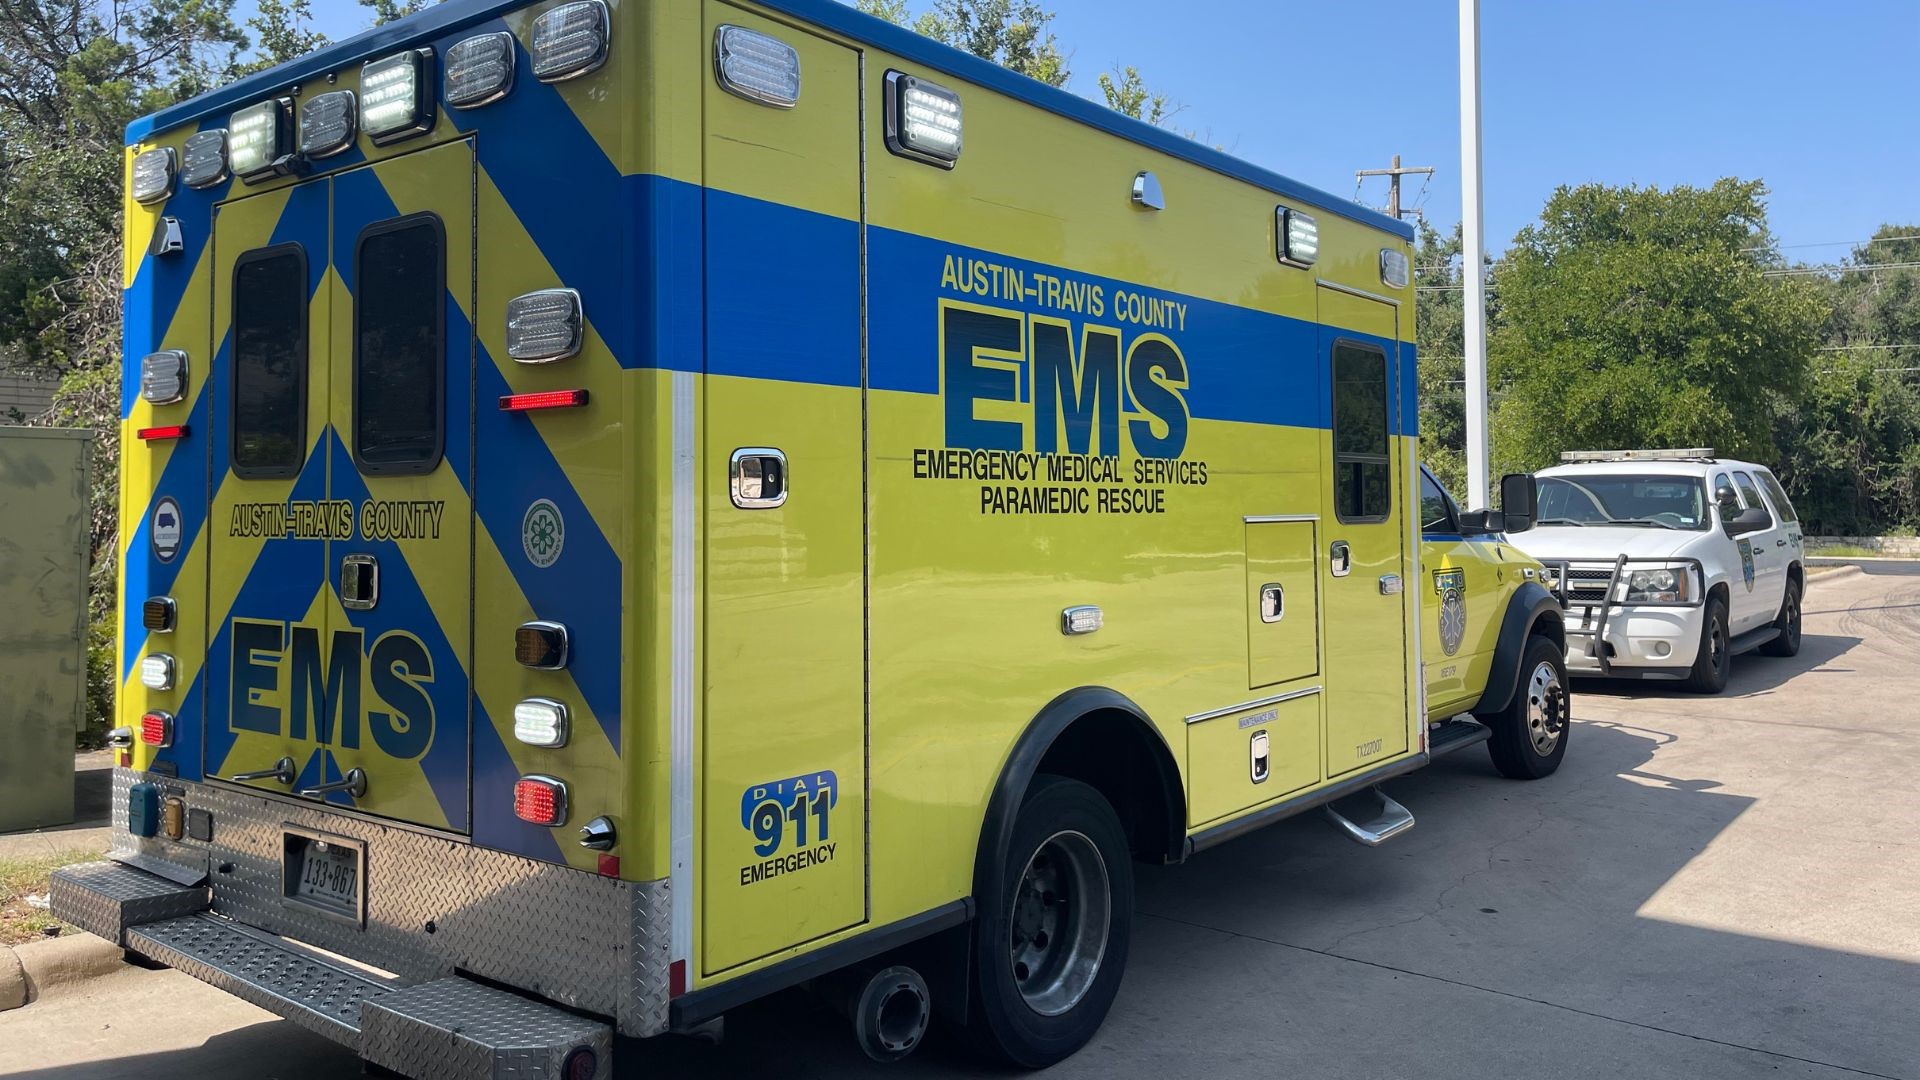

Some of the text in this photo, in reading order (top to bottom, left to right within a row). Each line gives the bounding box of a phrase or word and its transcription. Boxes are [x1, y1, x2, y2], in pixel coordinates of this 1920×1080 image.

[941, 254, 1187, 332] AUSTIN-TRAVIS COUNTY
[938, 298, 1190, 461] EMS
[913, 448, 1208, 486] EMERGENCY MEDICAL SERVICES
[229, 500, 445, 540] AUSTIN-TRAVIS COUNTY
[981, 486, 1165, 515] PARAMEDIC RESCUE
[229, 616, 435, 761] EMS
[753, 775, 827, 800] DIAL
[751, 786, 831, 858] 911
[740, 842, 837, 886] EMERGENCY
